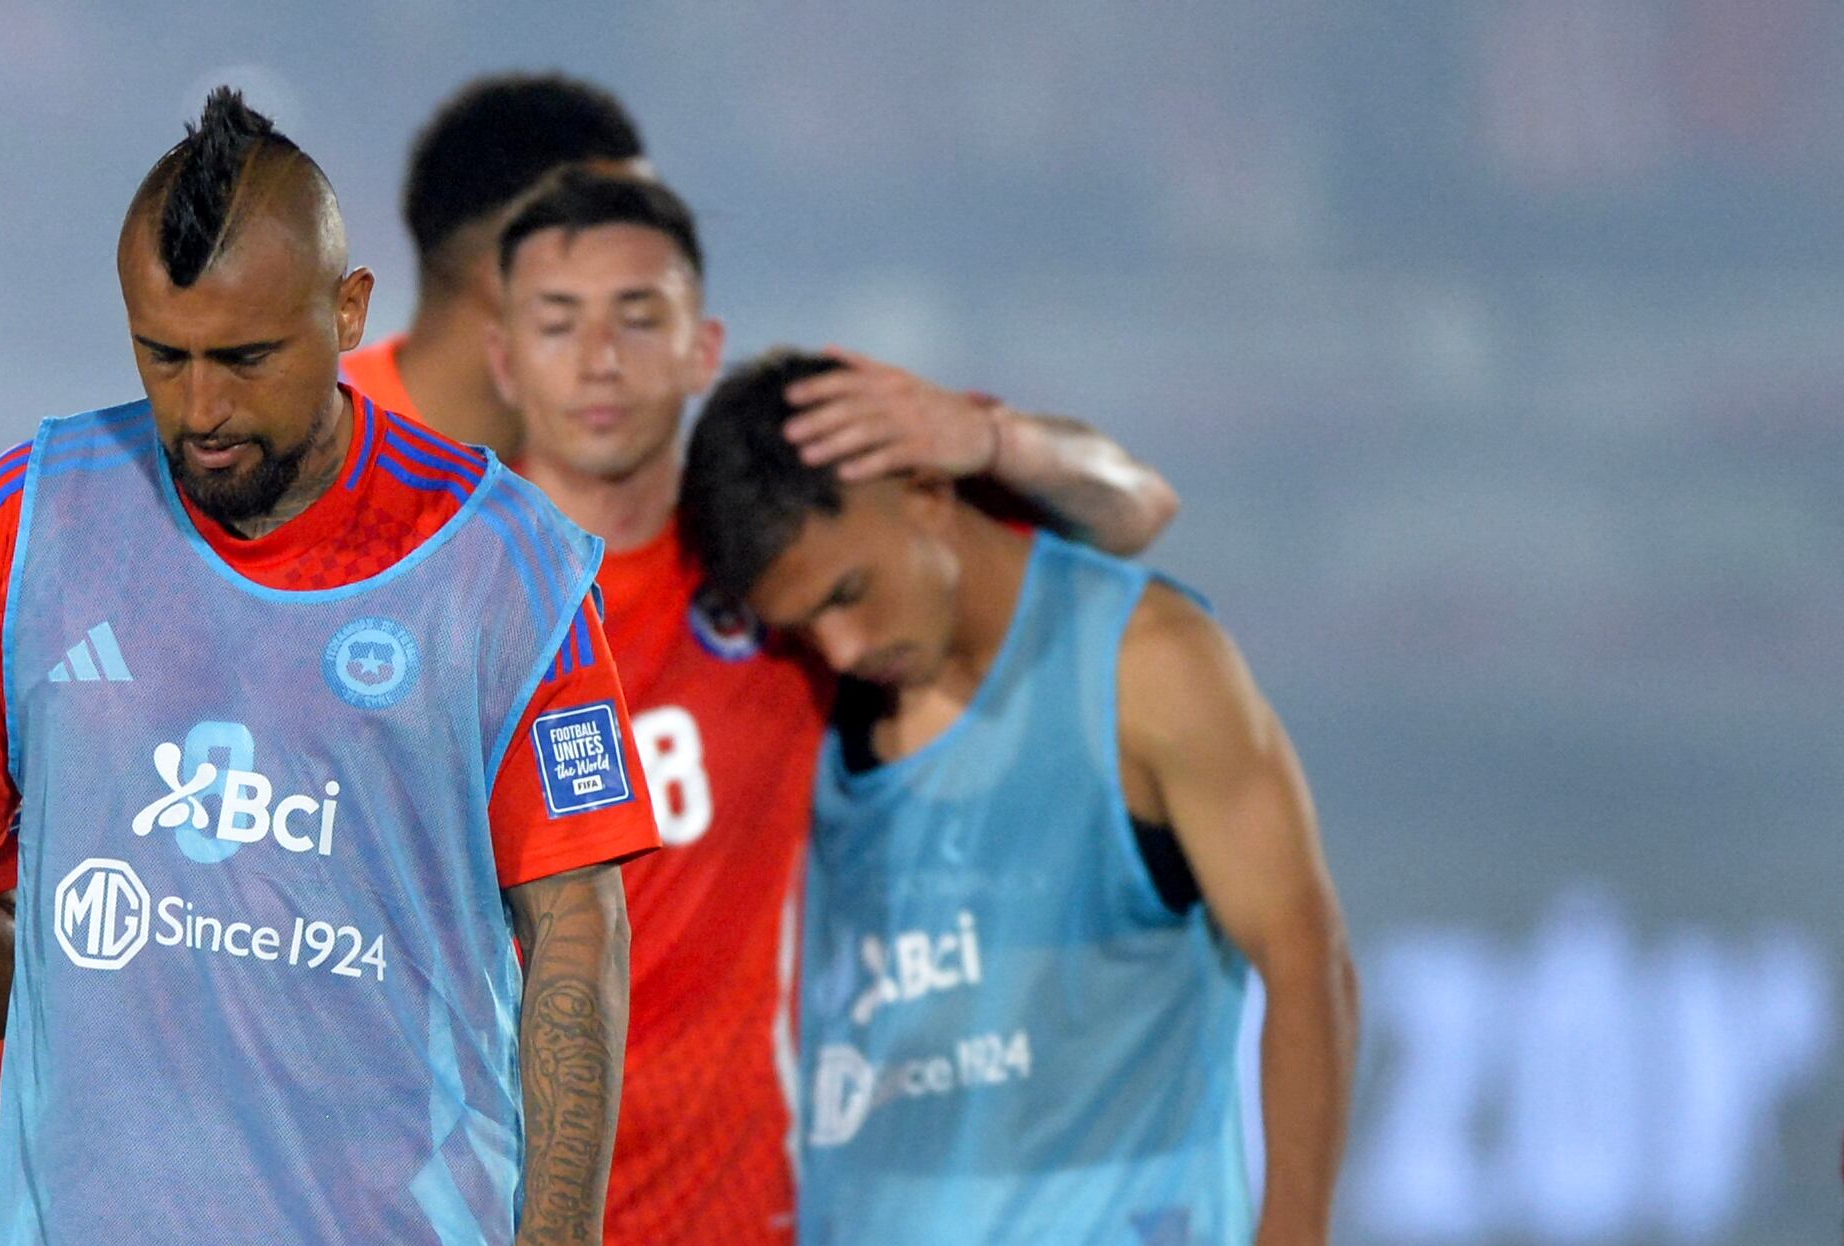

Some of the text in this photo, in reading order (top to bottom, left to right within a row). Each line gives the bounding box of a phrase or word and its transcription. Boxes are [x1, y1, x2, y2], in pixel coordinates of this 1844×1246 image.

[550, 720, 600, 744] FOOTBALL
[552, 735, 604, 762] UNITES
[554, 753, 610, 780] the World
[577, 780, 599, 791] FIFA
[216, 769, 340, 855] Bci
[58, 864, 146, 964] MG
[156, 896, 387, 981] Since 1924
